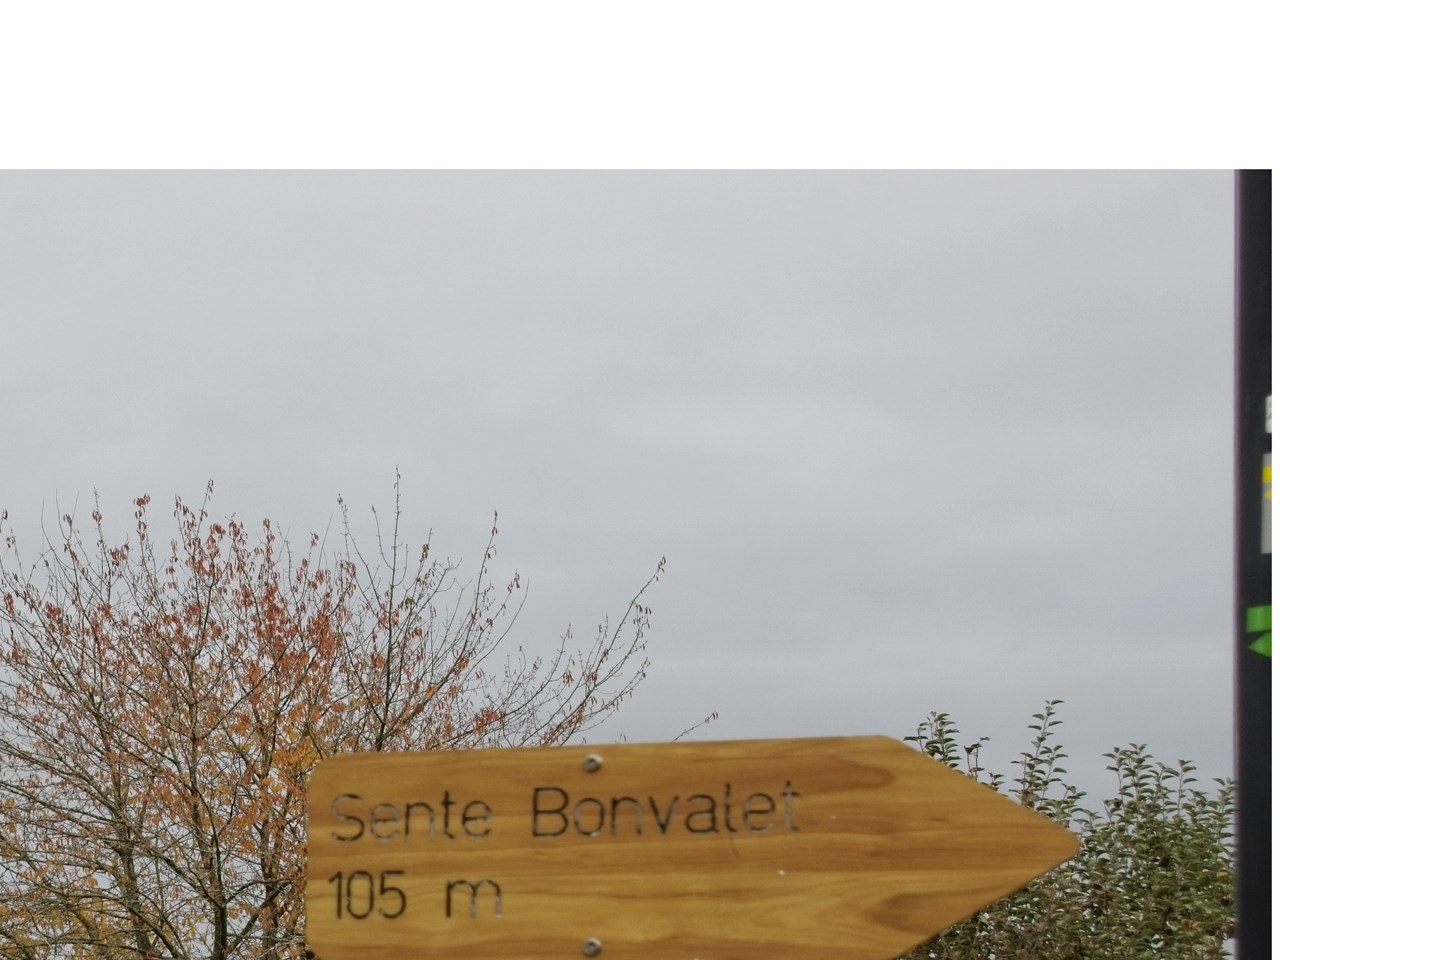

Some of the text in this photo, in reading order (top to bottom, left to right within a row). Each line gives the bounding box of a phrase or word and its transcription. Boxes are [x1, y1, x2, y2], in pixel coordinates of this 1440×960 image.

[329, 780, 801, 843] Sente Bonvalet
[328, 870, 503, 920] 105 m
